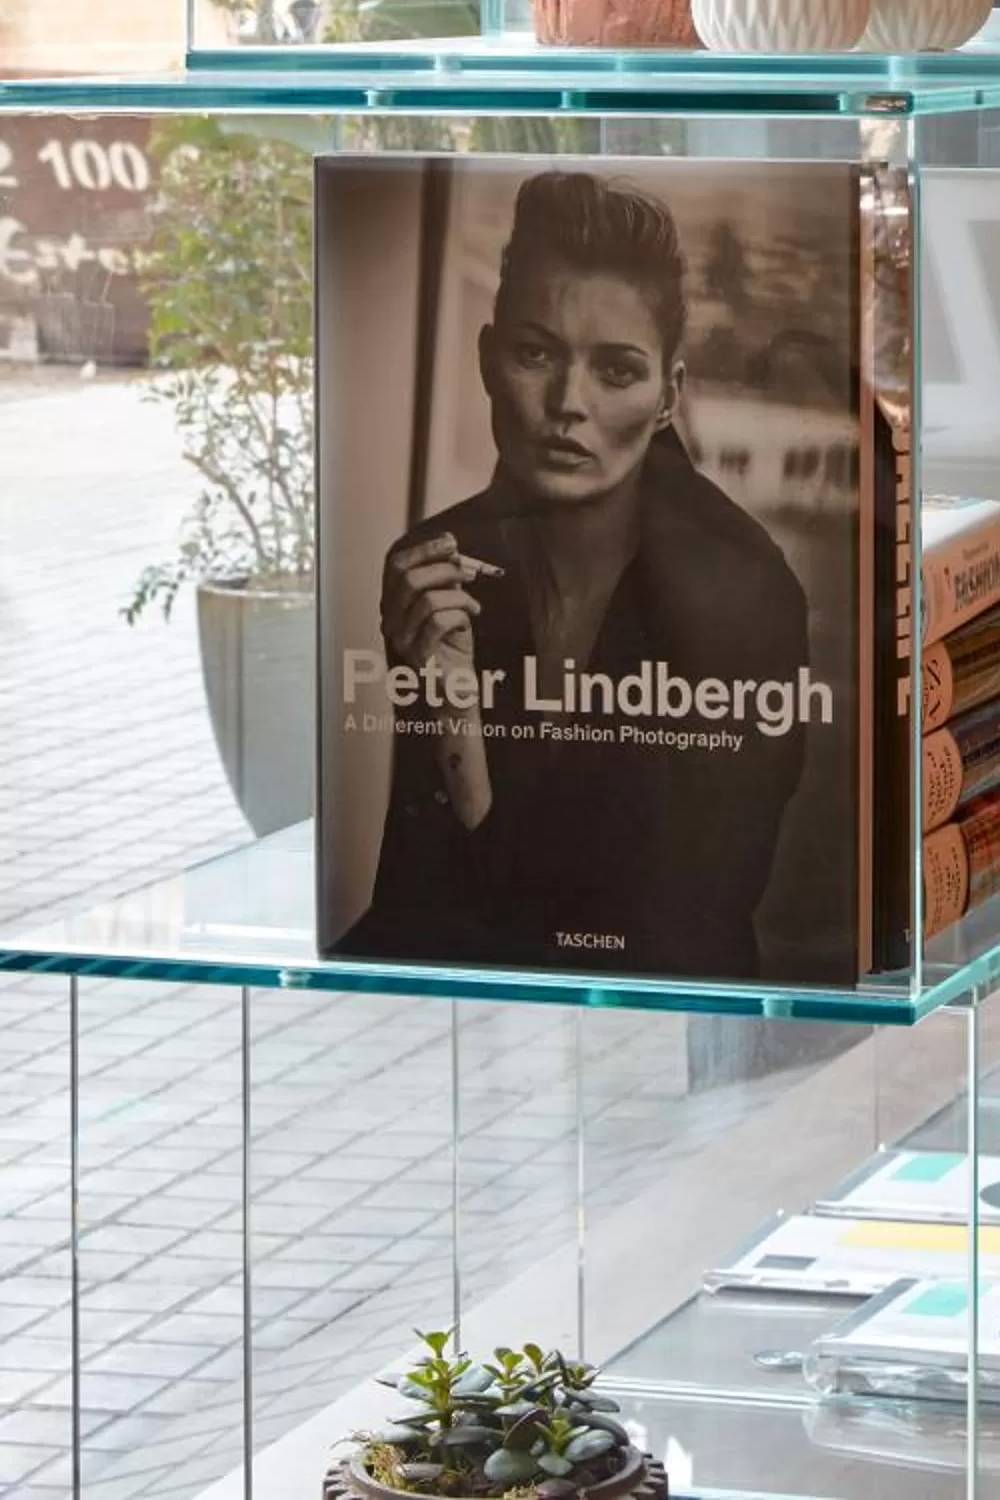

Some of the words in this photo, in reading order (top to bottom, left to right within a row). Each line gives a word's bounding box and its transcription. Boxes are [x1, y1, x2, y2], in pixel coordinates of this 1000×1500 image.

[37, 139, 150, 192] 100
[343, 648, 506, 709] Peter
[524, 654, 833, 737] Lindbergh
[344, 713, 358, 733] A
[511, 723, 534, 740] on
[540, 723, 615, 743] Fashion
[619, 725, 744, 752] Photography
[555, 931, 626, 951] TASCHEN
